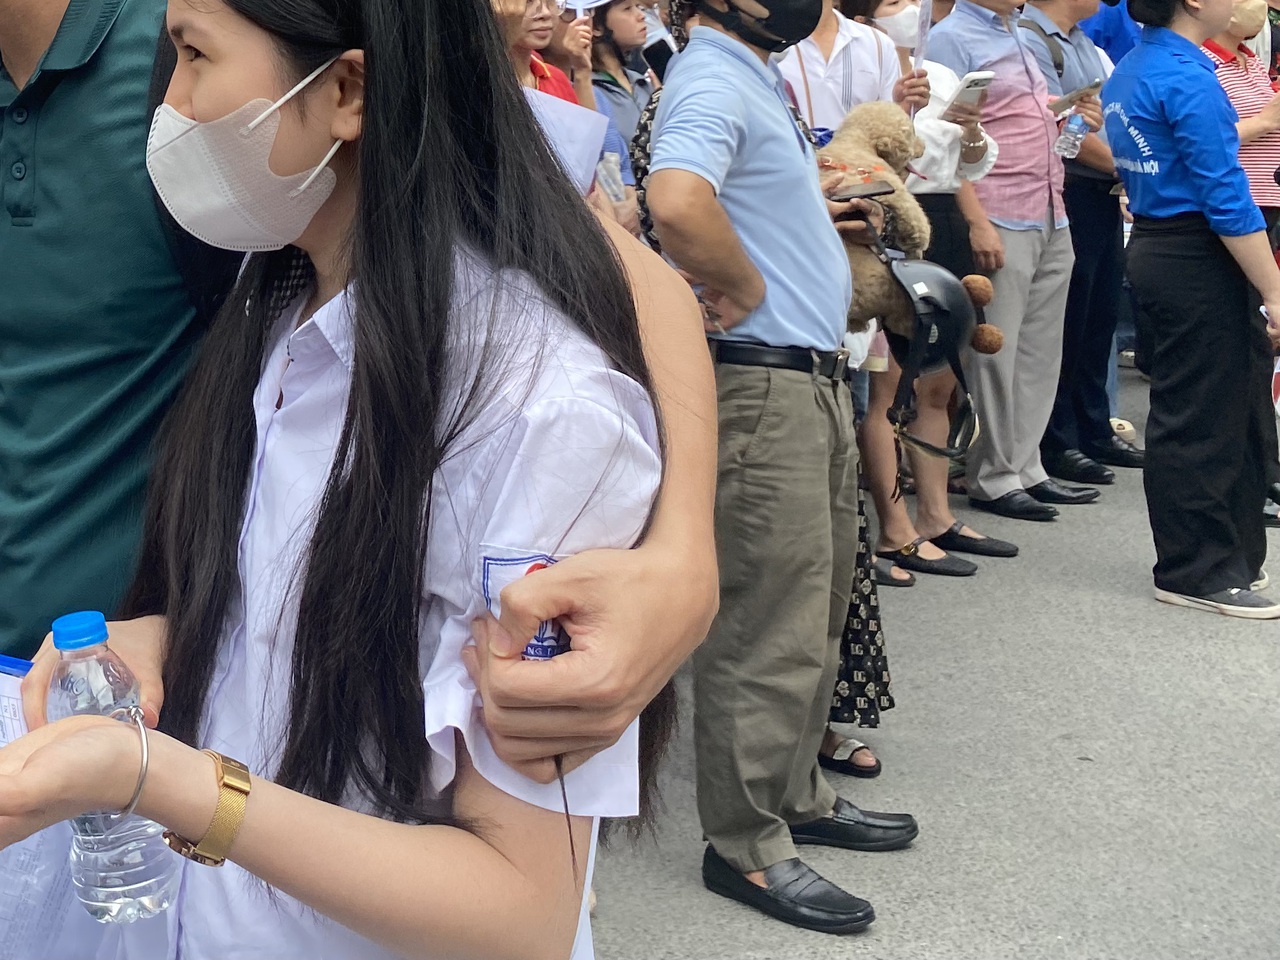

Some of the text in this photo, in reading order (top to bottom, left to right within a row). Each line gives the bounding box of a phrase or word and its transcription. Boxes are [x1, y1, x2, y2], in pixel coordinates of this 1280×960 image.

[1128, 126, 1153, 157] MINH
[1143, 159, 1159, 176] NỘI
[527, 646, 542, 655] NG
